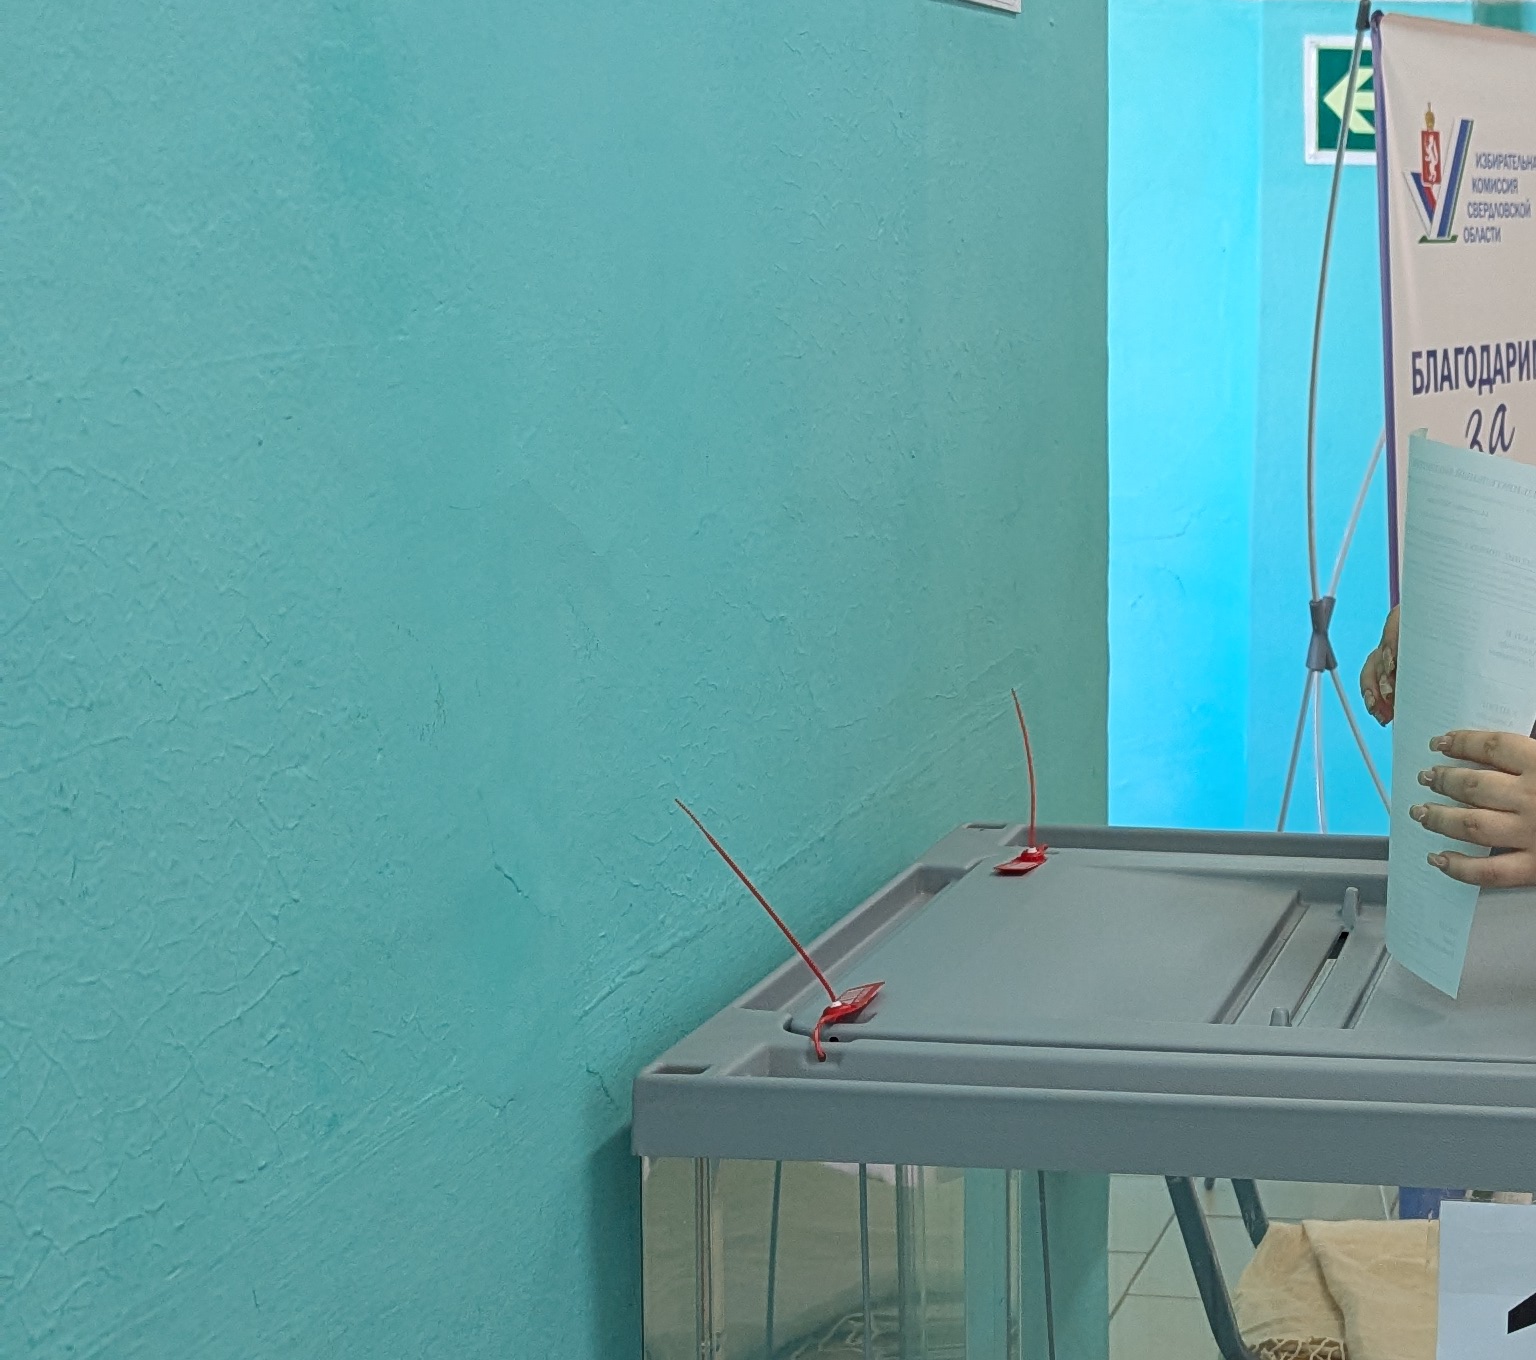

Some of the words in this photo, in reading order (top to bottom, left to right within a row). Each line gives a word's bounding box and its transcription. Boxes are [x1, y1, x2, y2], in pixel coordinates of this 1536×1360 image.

[1472, 177, 1519, 194] КОМИССИЯ
[1467, 198, 1532, 220] СВЕРДЛОВСКОЙ
[1463, 226, 1502, 243] ОБЛАСТИ
